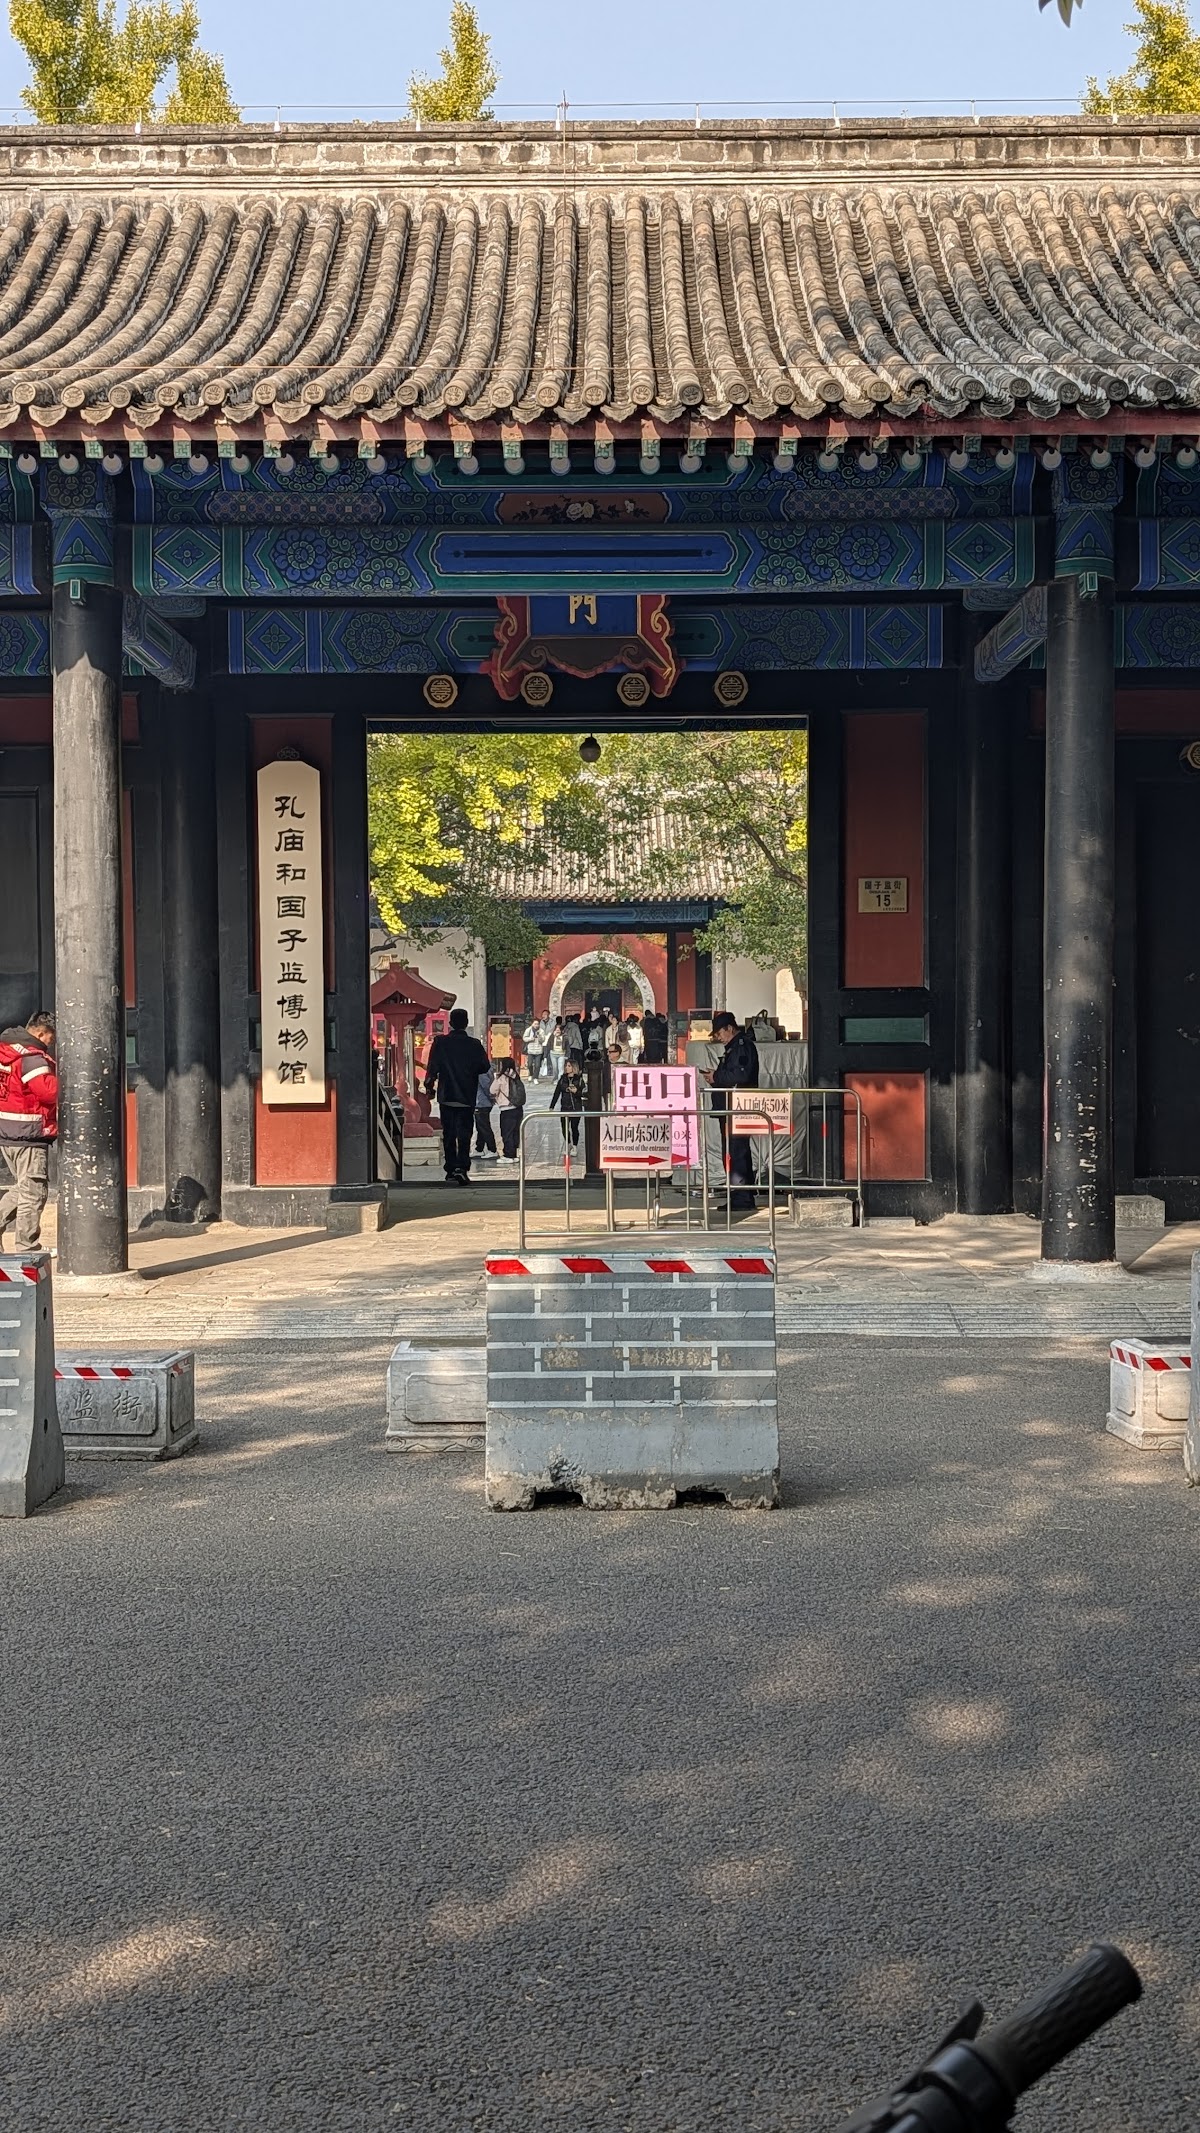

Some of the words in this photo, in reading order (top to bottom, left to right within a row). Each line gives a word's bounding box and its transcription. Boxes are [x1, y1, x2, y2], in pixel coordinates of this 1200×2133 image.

[876, 894, 891, 907] 15
[274, 795, 309, 1086] 孔庙和国子监博物馆
[619, 1070, 692, 1100] 出口
[736, 1097, 789, 1113] 入口向东50米
[602, 1123, 670, 1144] 入口向东50米
[635, 1144, 641, 1152] of
